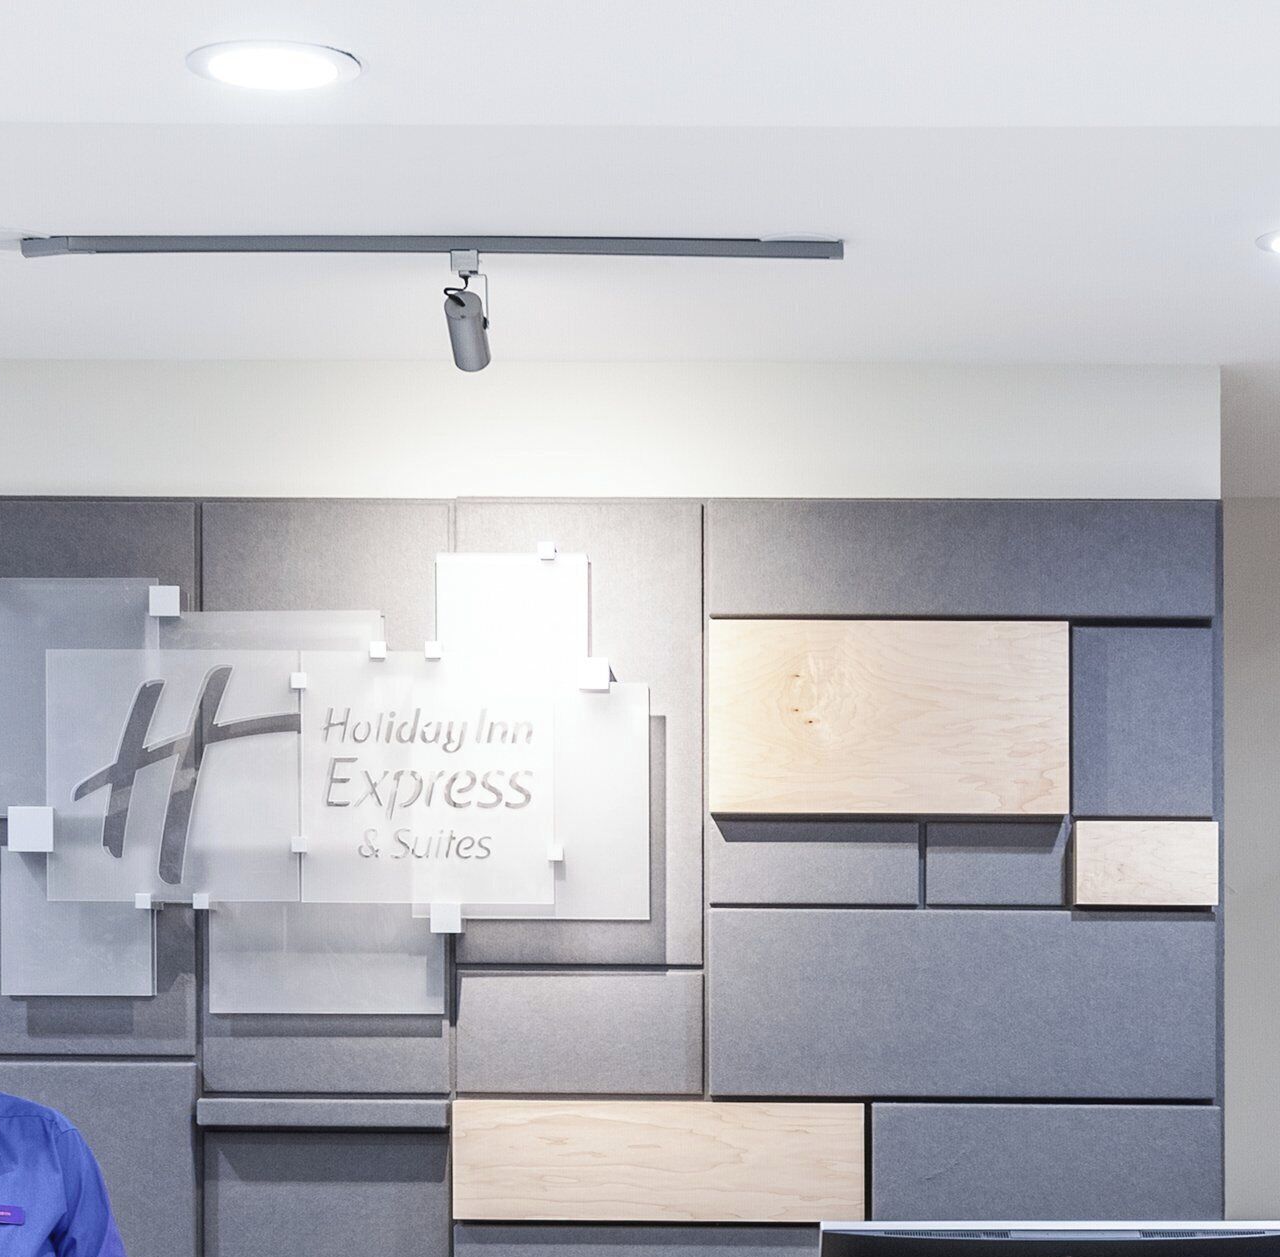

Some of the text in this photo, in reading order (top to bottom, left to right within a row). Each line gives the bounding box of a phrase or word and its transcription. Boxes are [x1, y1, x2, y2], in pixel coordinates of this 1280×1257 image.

[322, 707, 533, 753] Holiday Inn
[323, 756, 534, 820] Express
[357, 828, 492, 859] & Suites
